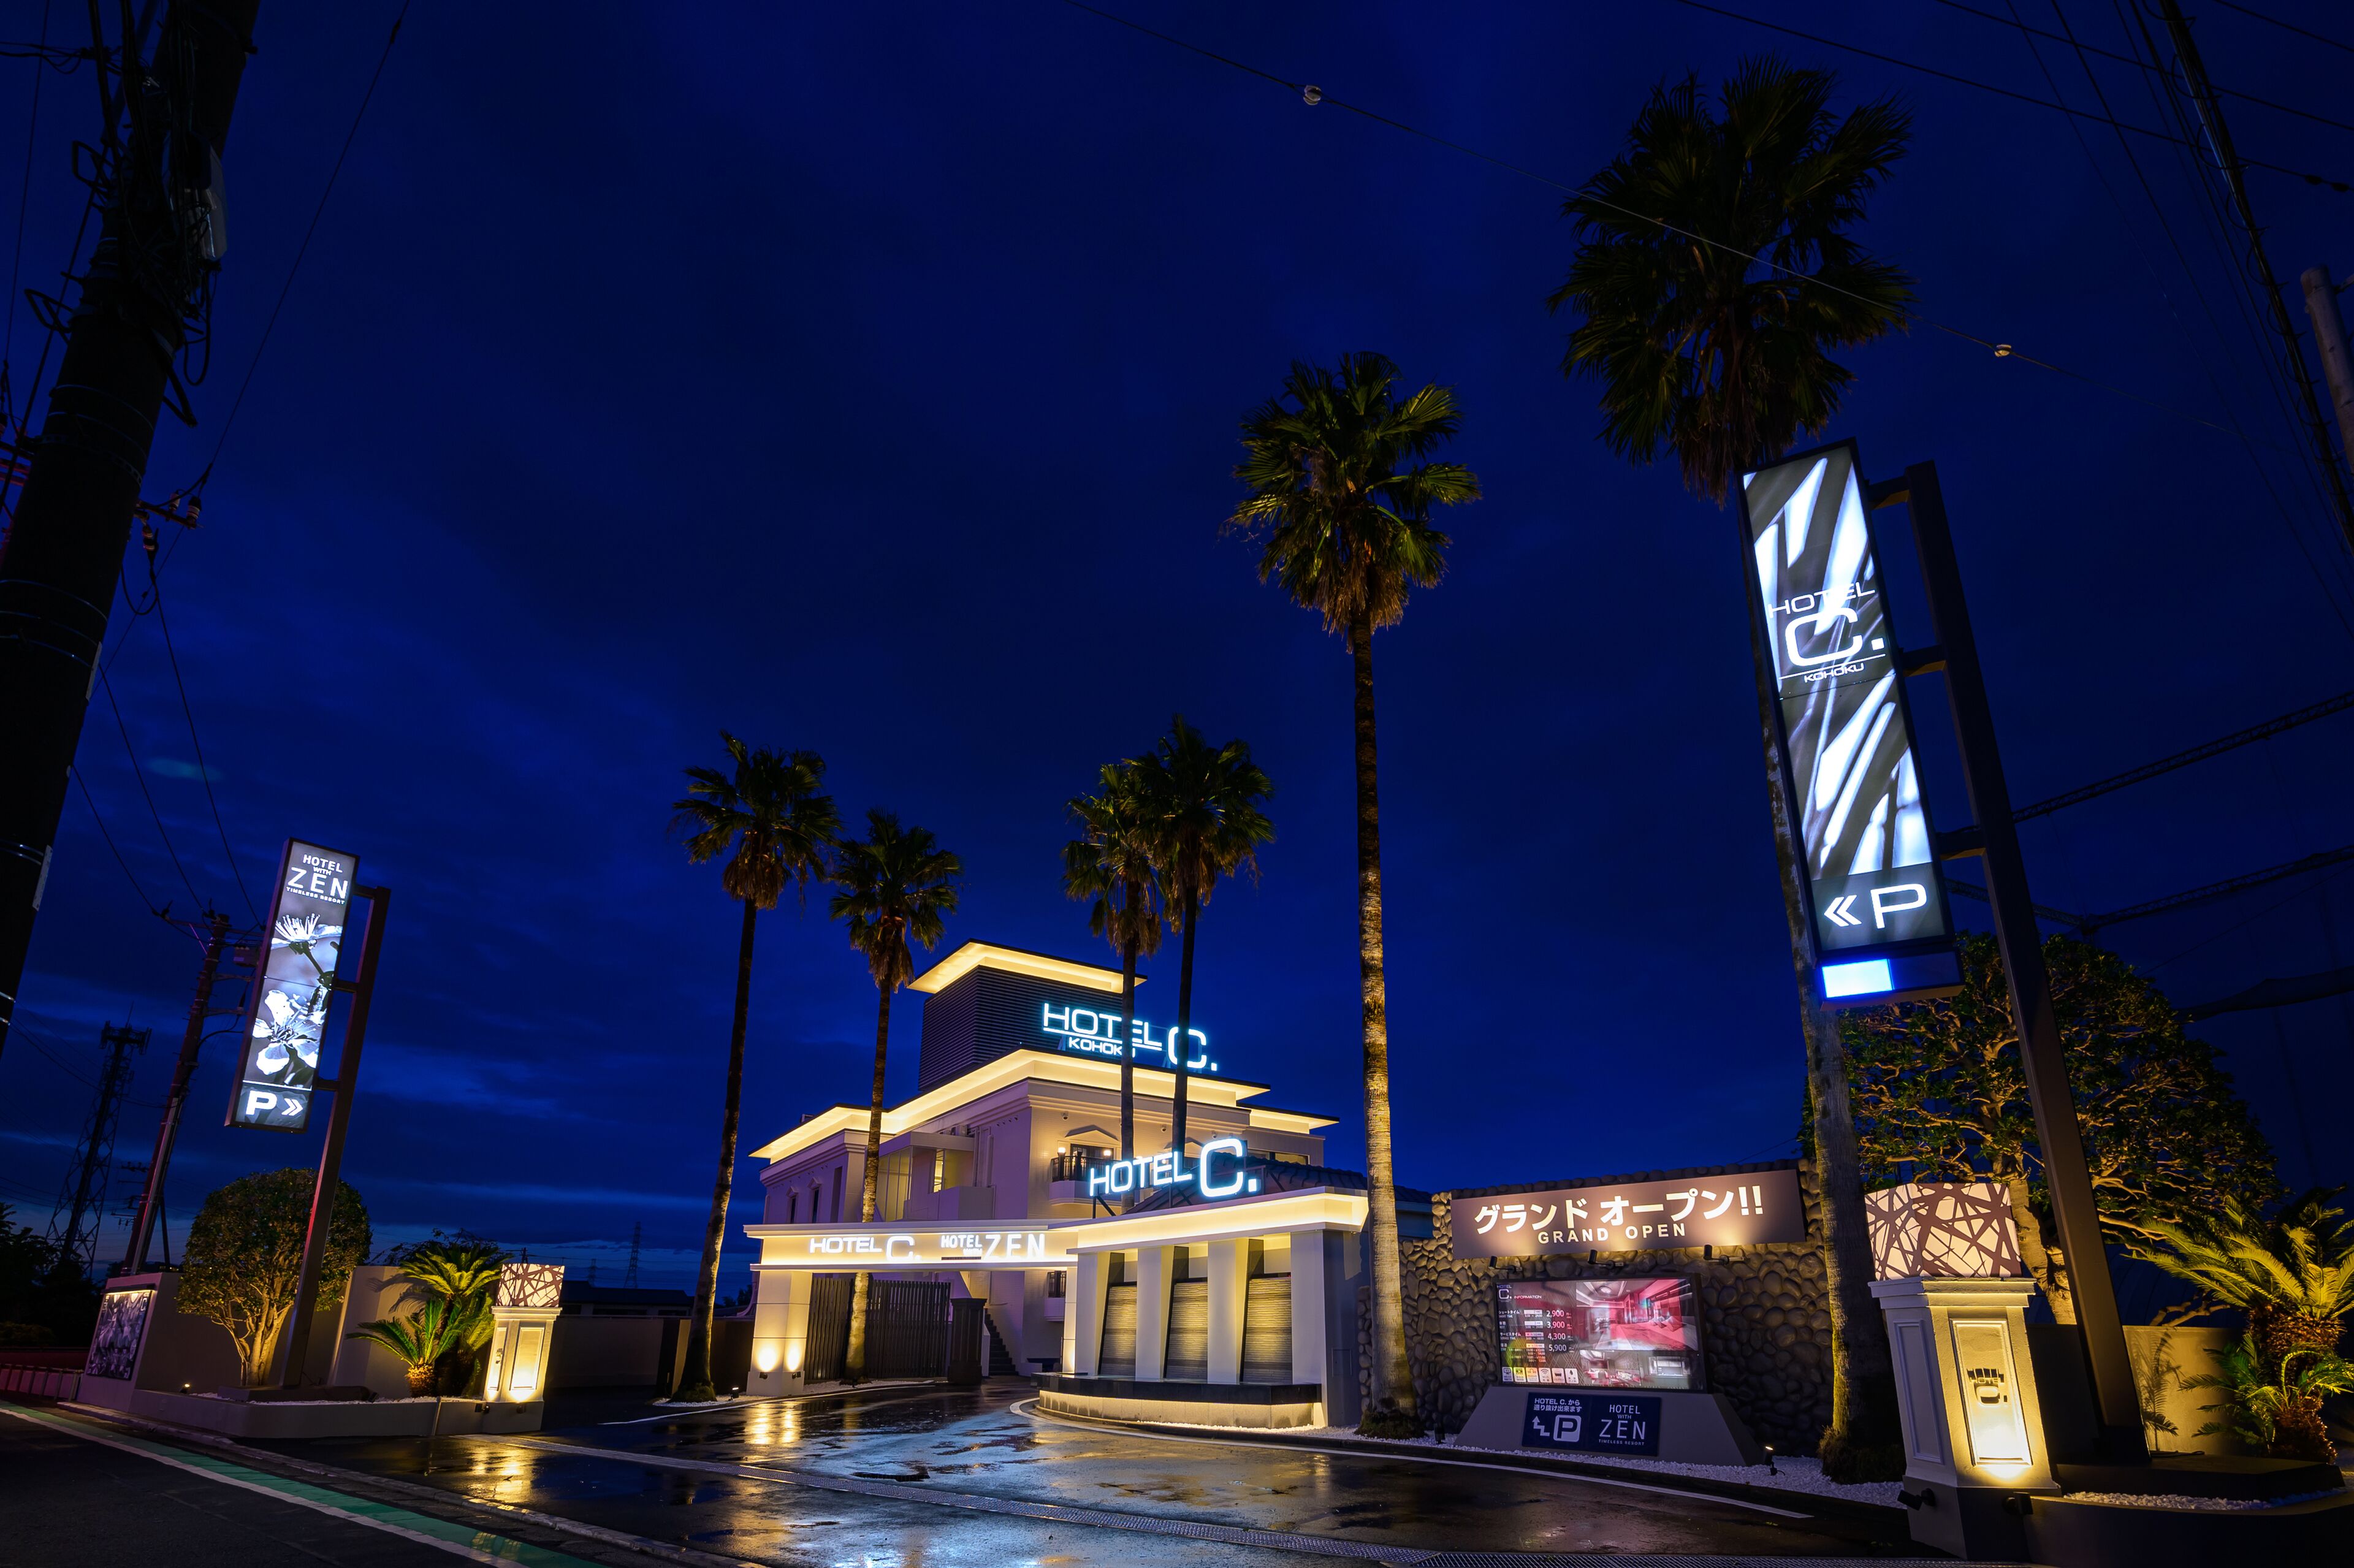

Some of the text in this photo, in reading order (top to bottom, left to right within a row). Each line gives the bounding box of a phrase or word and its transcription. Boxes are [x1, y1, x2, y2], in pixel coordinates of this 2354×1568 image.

[1767, 582, 1875, 618] HOTEL
[1804, 663, 1864, 683] KOHOKU
[303, 854, 343, 873] HOTEL
[313, 867, 332, 875] WITH
[286, 886, 318, 899] TIMELESS
[288, 867, 348, 899] ZEN
[1871, 883, 1927, 929] P
[1043, 1003, 1162, 1047] HOTEL
[1068, 1037, 1136, 1058] KOHOK
[245, 1090, 278, 1116] P
[1089, 1138, 1257, 1197] HOTEL C.
[1474, 1198, 1588, 1235] グランド
[1538, 1223, 1686, 1244] GRAND OPEN
[809, 1236, 882, 1253] HOTEL
[941, 1233, 1045, 1260] HOTEL ZEN
[1609, 1404, 1640, 1414] HOTEL
[1599, 1419, 1646, 1439] ZEN
